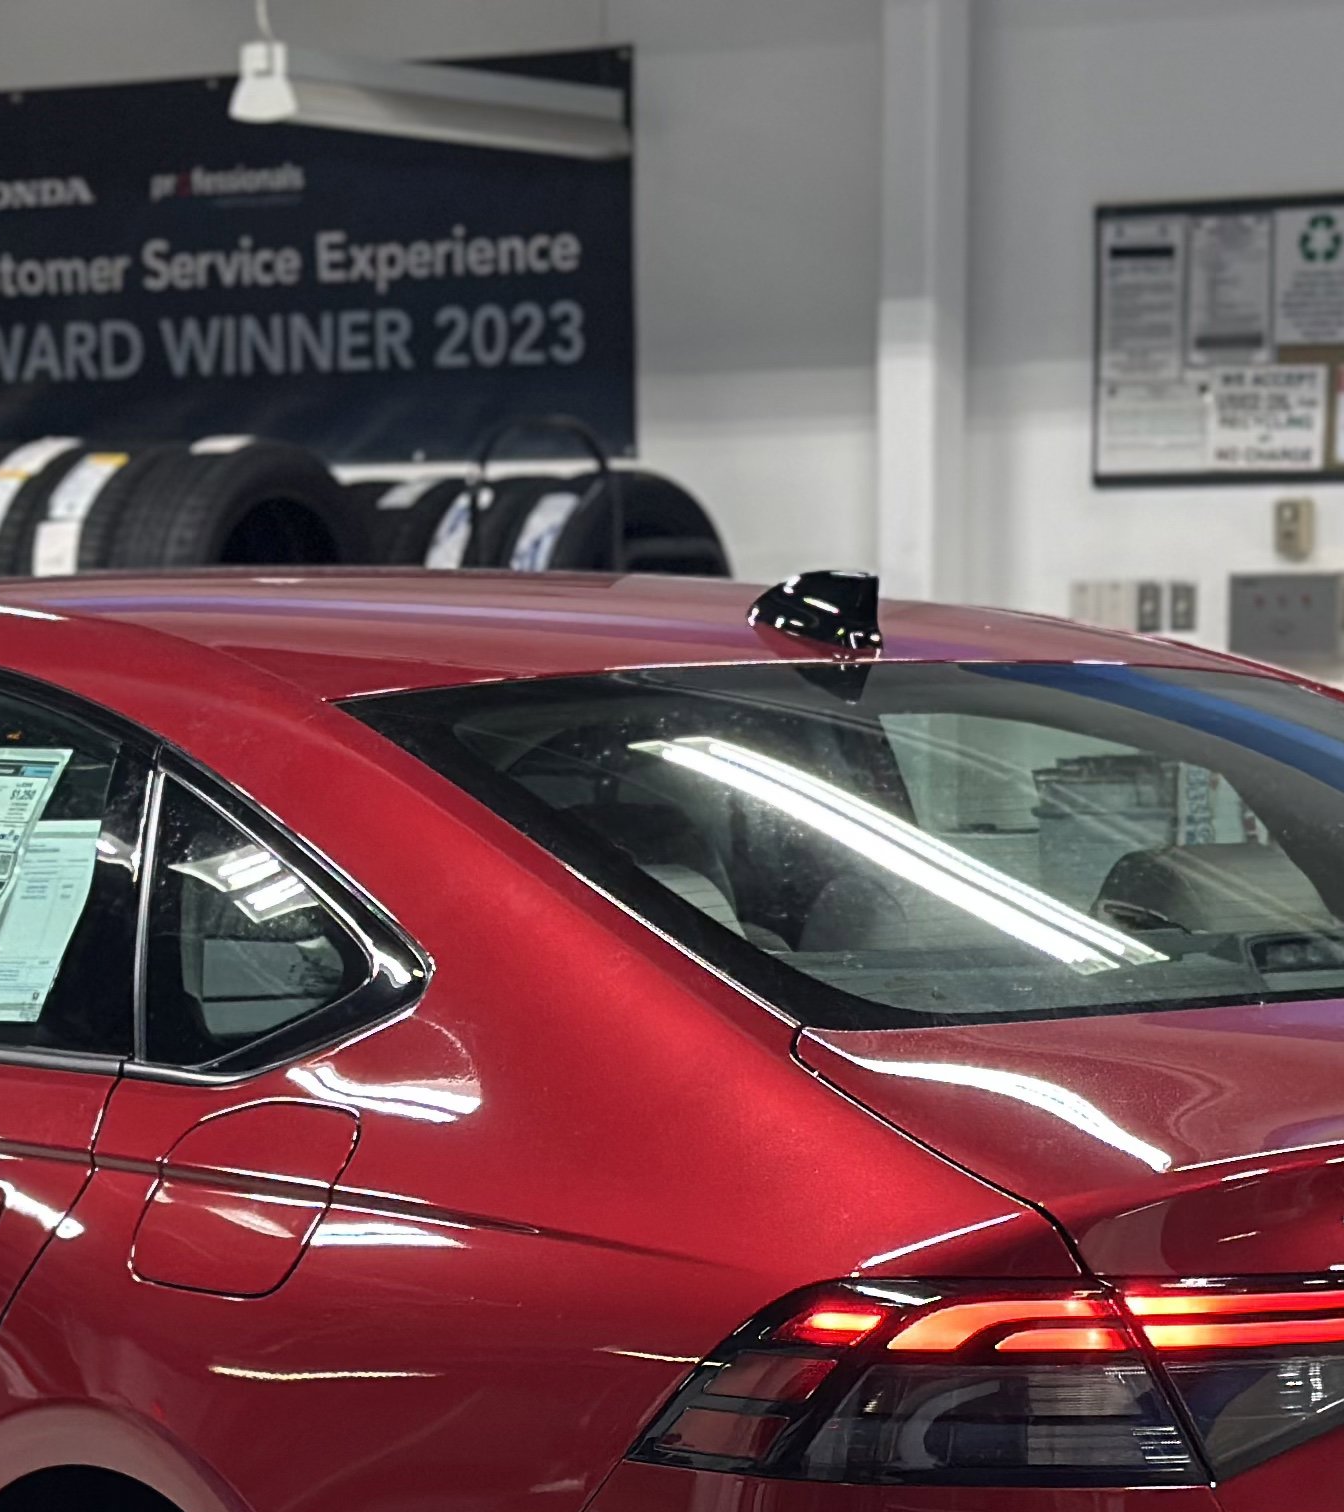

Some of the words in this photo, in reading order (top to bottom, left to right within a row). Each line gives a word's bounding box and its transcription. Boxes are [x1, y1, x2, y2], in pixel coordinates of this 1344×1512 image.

[141, 235, 302, 291] Service
[315, 224, 581, 294] Experience
[160, 309, 413, 376] WINNER
[435, 300, 584, 367] 2023
